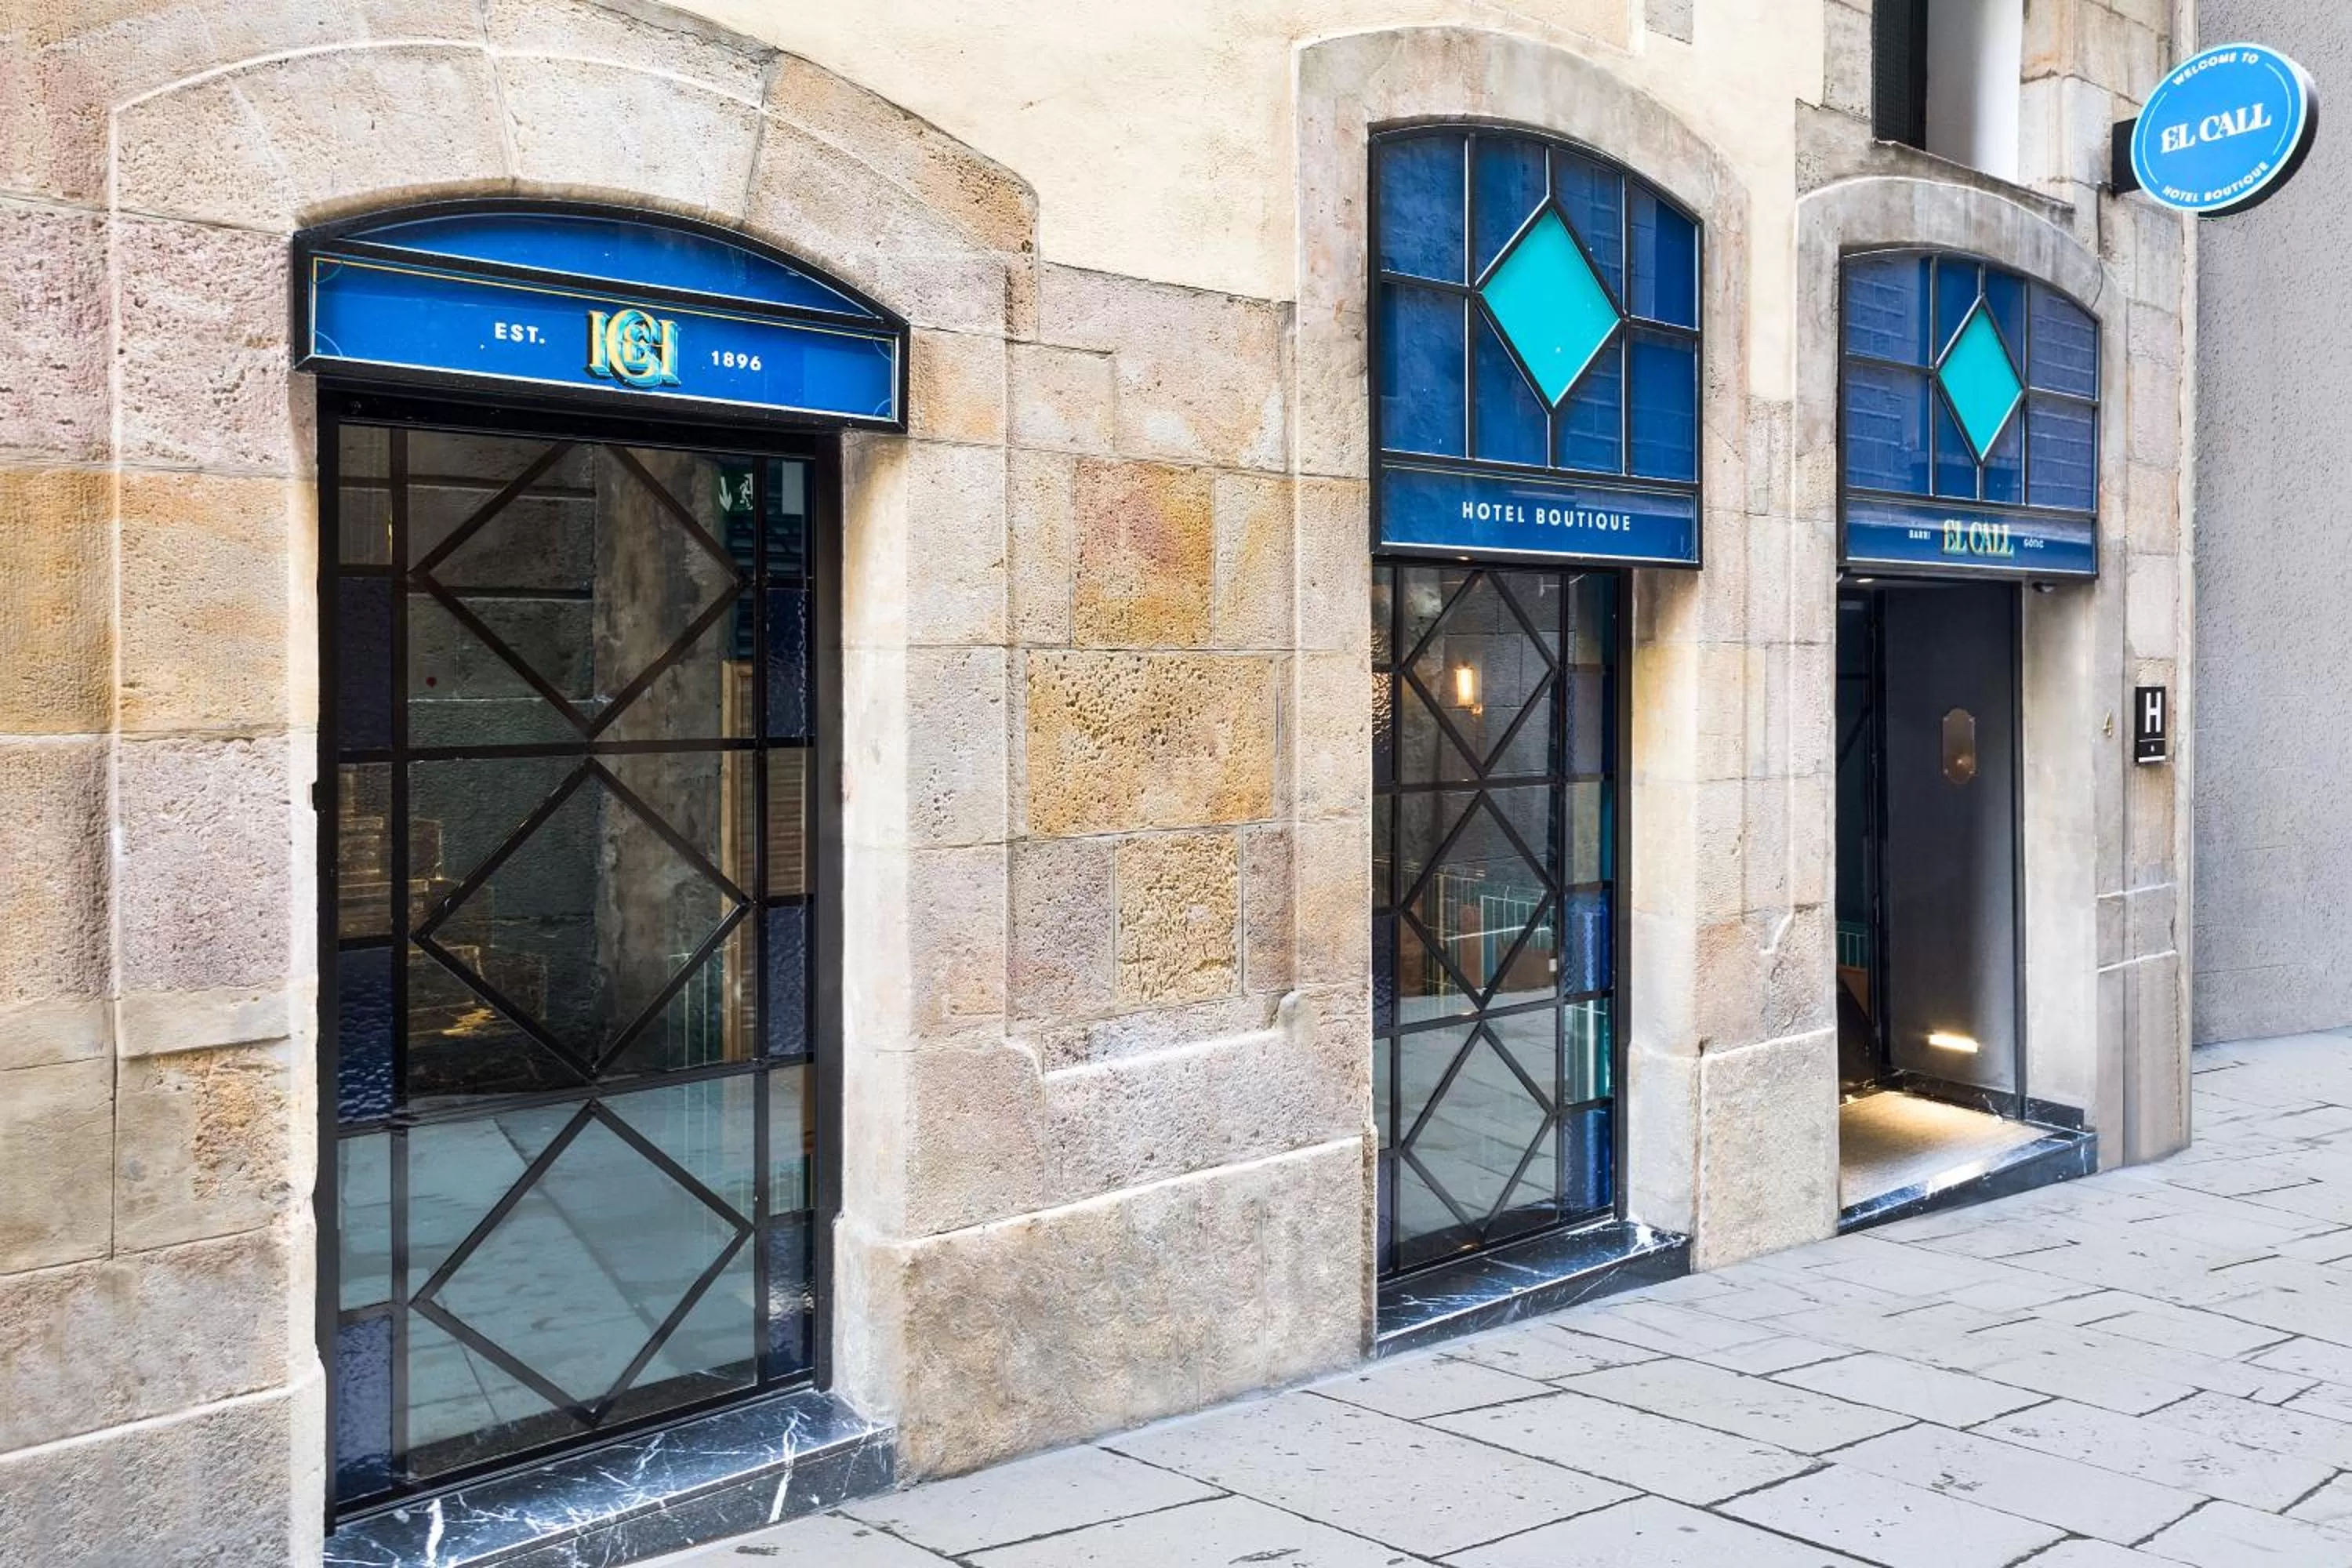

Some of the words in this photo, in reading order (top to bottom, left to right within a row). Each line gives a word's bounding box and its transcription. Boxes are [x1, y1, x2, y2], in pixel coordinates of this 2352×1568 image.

[2172, 52, 2237, 85] WELCOME
[2241, 52, 2259, 64] TO
[2160, 123, 2196, 154] EL
[2199, 103, 2271, 142] CALL
[2162, 185, 2198, 202] HOTEL
[2204, 162, 2269, 201] BOUTIQUE
[494, 322, 546, 344] EST.
[711, 350, 762, 371] 1896
[1462, 501, 1524, 523] HOTEL
[1536, 508, 1631, 531] BOUTIQUE
[1943, 518, 1967, 554] EL
[1969, 521, 2015, 558] CALL
[2145, 691, 2161, 733] H
